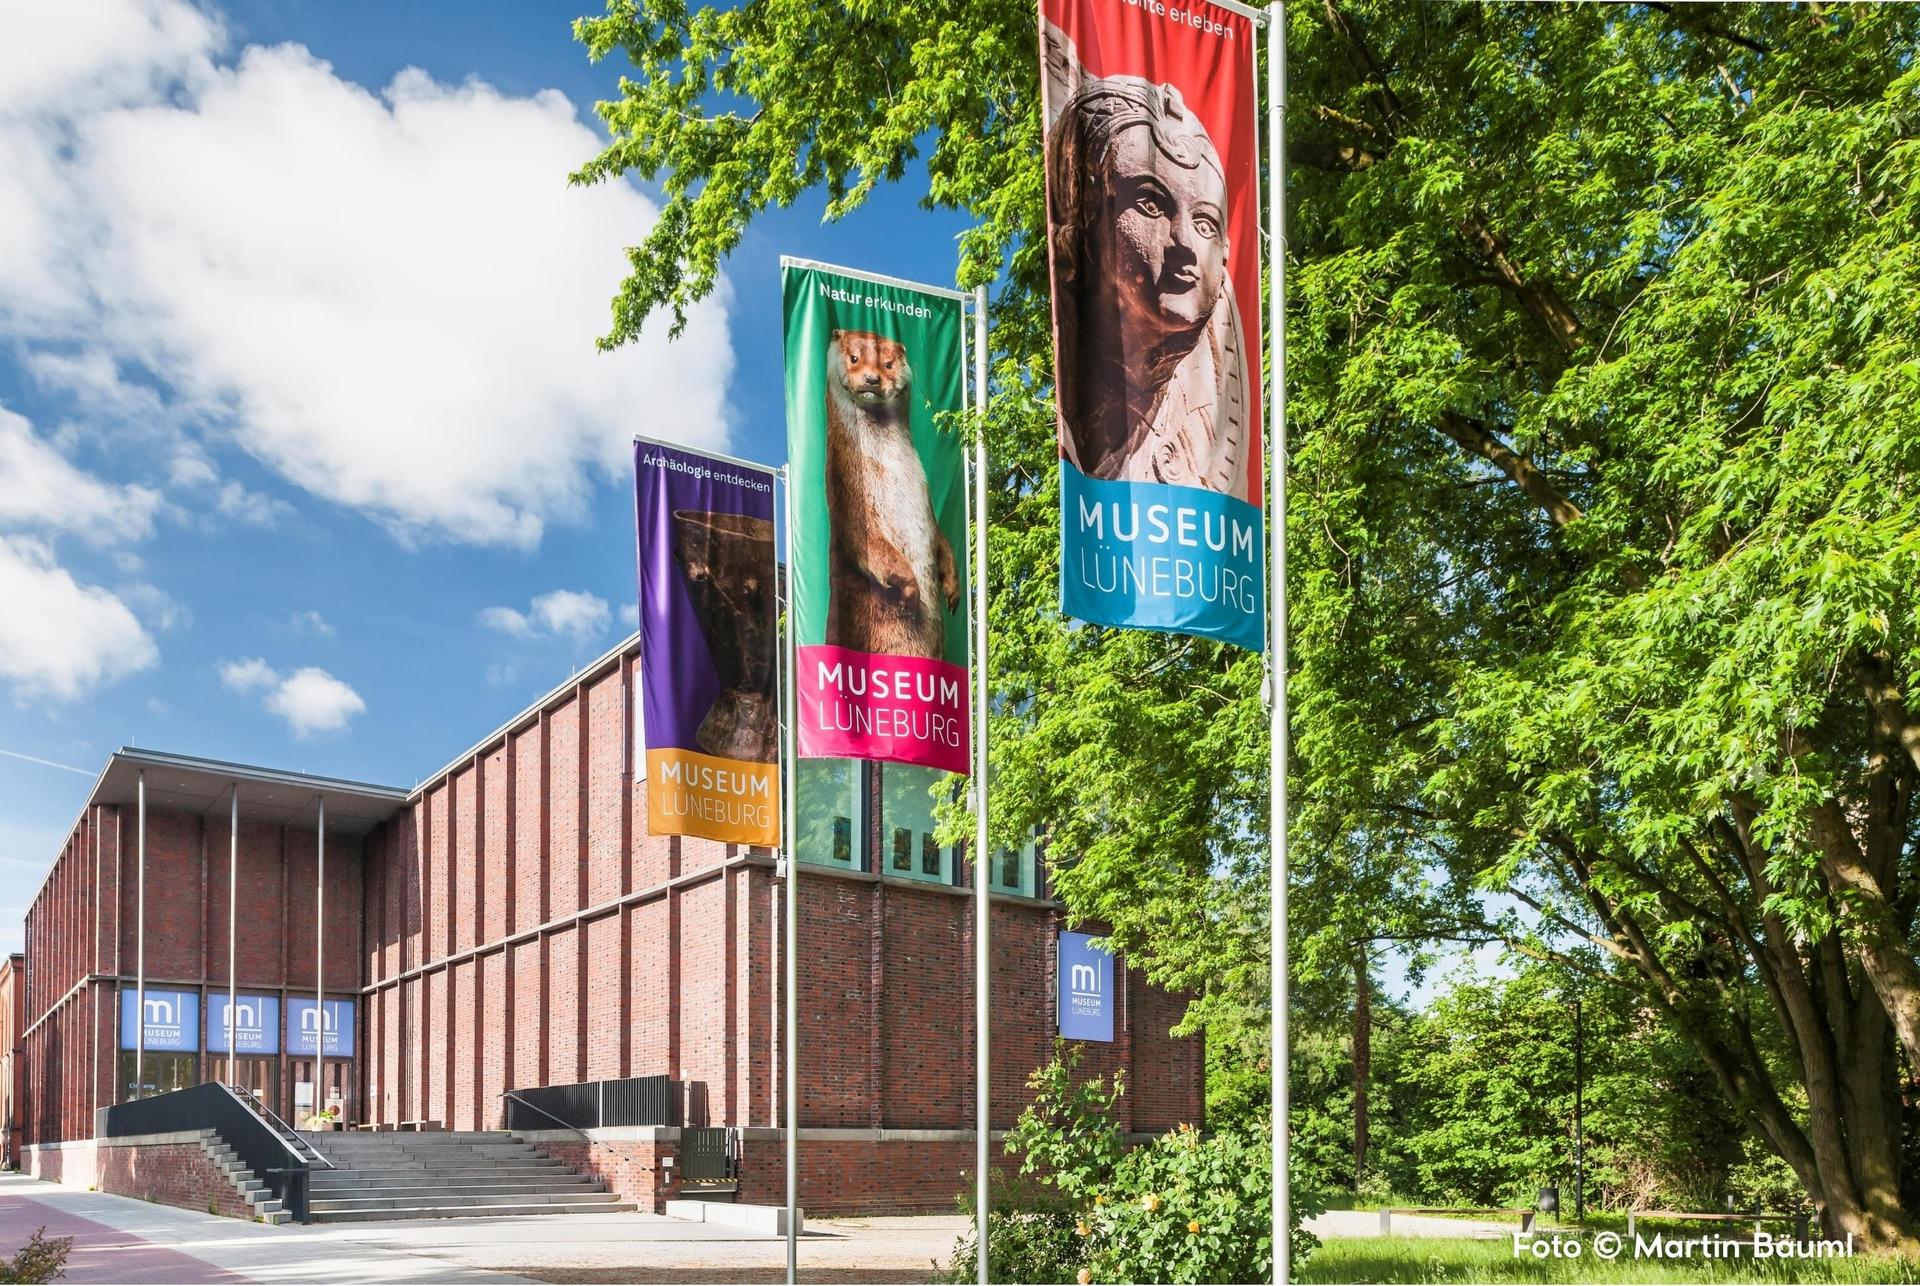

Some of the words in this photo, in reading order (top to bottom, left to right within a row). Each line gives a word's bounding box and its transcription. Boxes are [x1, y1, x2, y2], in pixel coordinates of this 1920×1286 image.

[1170, 8, 1234, 40] erleben
[820, 282, 862, 305] Natur
[865, 294, 932, 319] erkunden
[643, 454, 711, 479] Archäologie
[713, 471, 770, 493] entdecken
[1079, 494, 1253, 563] MUSEUM
[1081, 545, 1255, 614] LÜNEBURG
[818, 661, 959, 709] MUSEUM
[820, 694, 960, 747] LÜNEBURG
[661, 761, 769, 798] MUSEUM
[662, 786, 770, 828] LÜNEBURG
[1072, 997, 1101, 1006] MUSEUM
[224, 1031, 262, 1040] MSEUM
